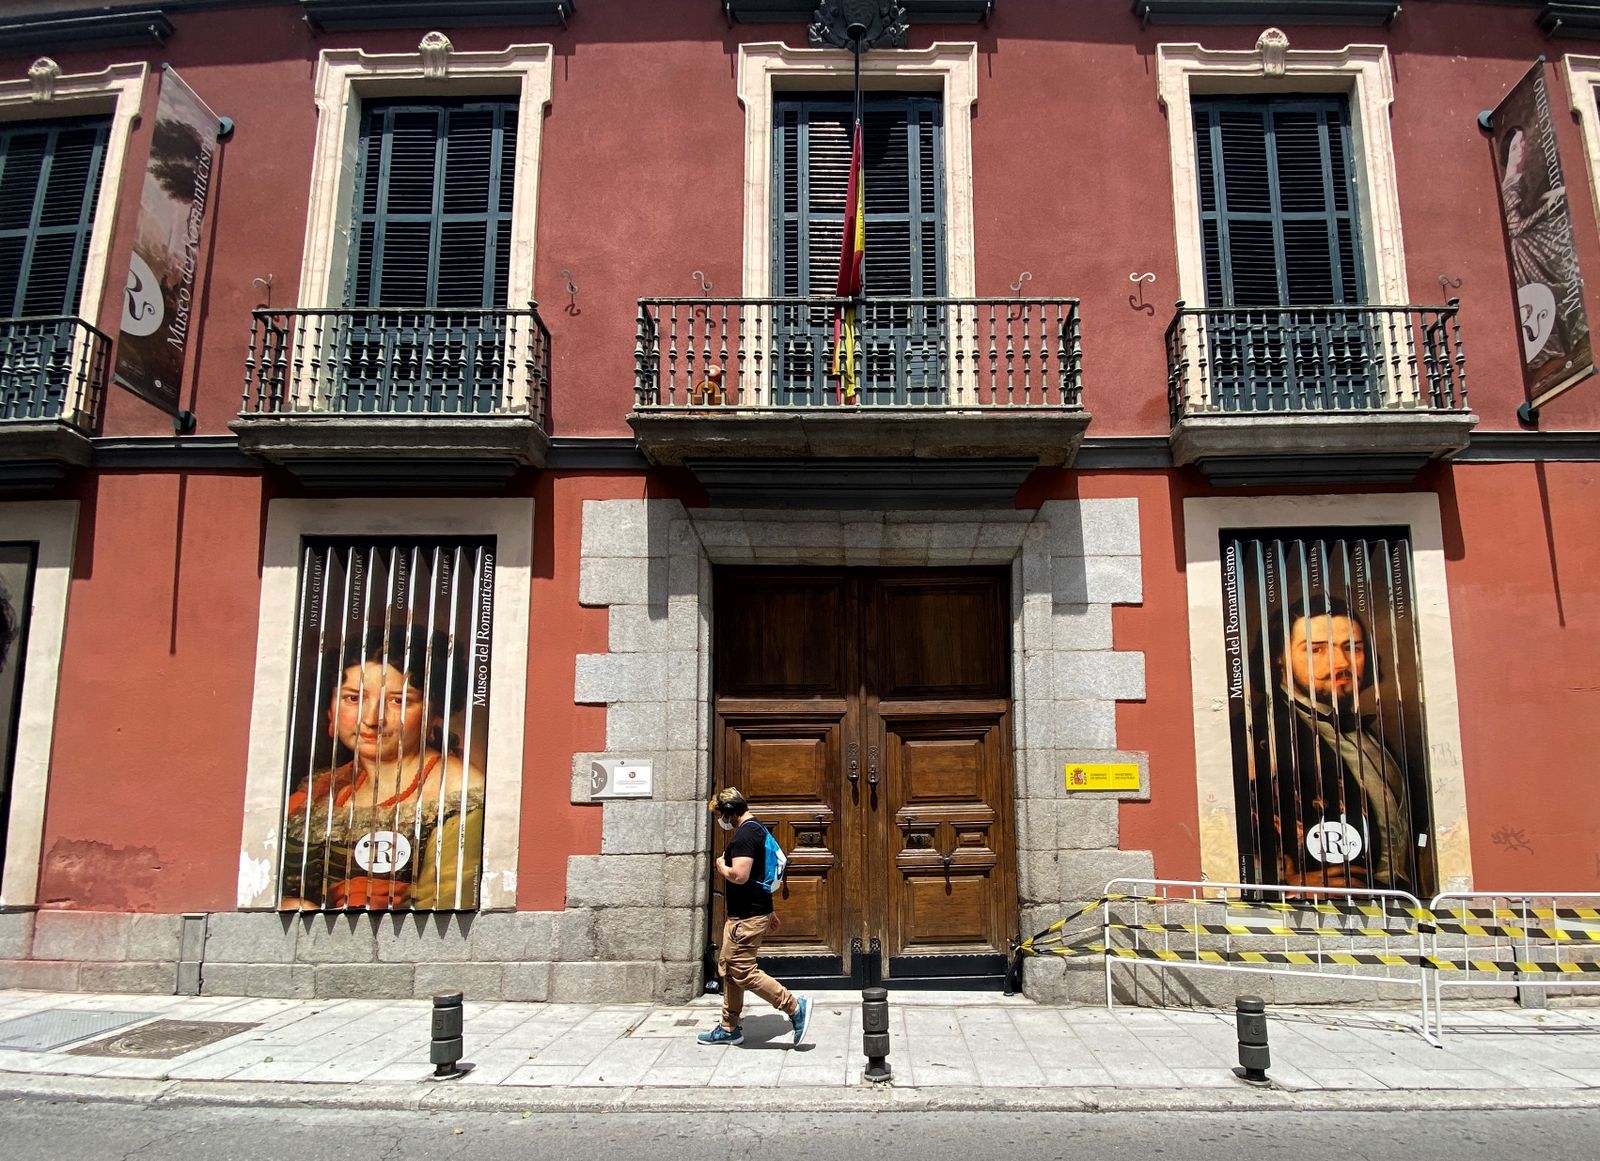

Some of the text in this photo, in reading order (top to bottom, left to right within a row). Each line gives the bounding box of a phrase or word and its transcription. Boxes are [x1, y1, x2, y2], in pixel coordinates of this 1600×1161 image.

[166, 287, 192, 352] Museo
[351, 553, 363, 620] CONFERENCIAS
[396, 554, 408, 609] CONCIERTOS
[441, 554, 450, 595] TALLERES
[1265, 547, 1275, 603] CONCIERTOS
[1310, 546, 1319, 588] TALLERES
[1355, 546, 1365, 612] CONFERENCIAS
[1393, 547, 1404, 619] VISITAS GUIADAS
[309, 594, 319, 627] VISITAS
[473, 553, 494, 707] Museo del Romanticismo
[1224, 546, 1242, 699] Museo del Romanticismo
